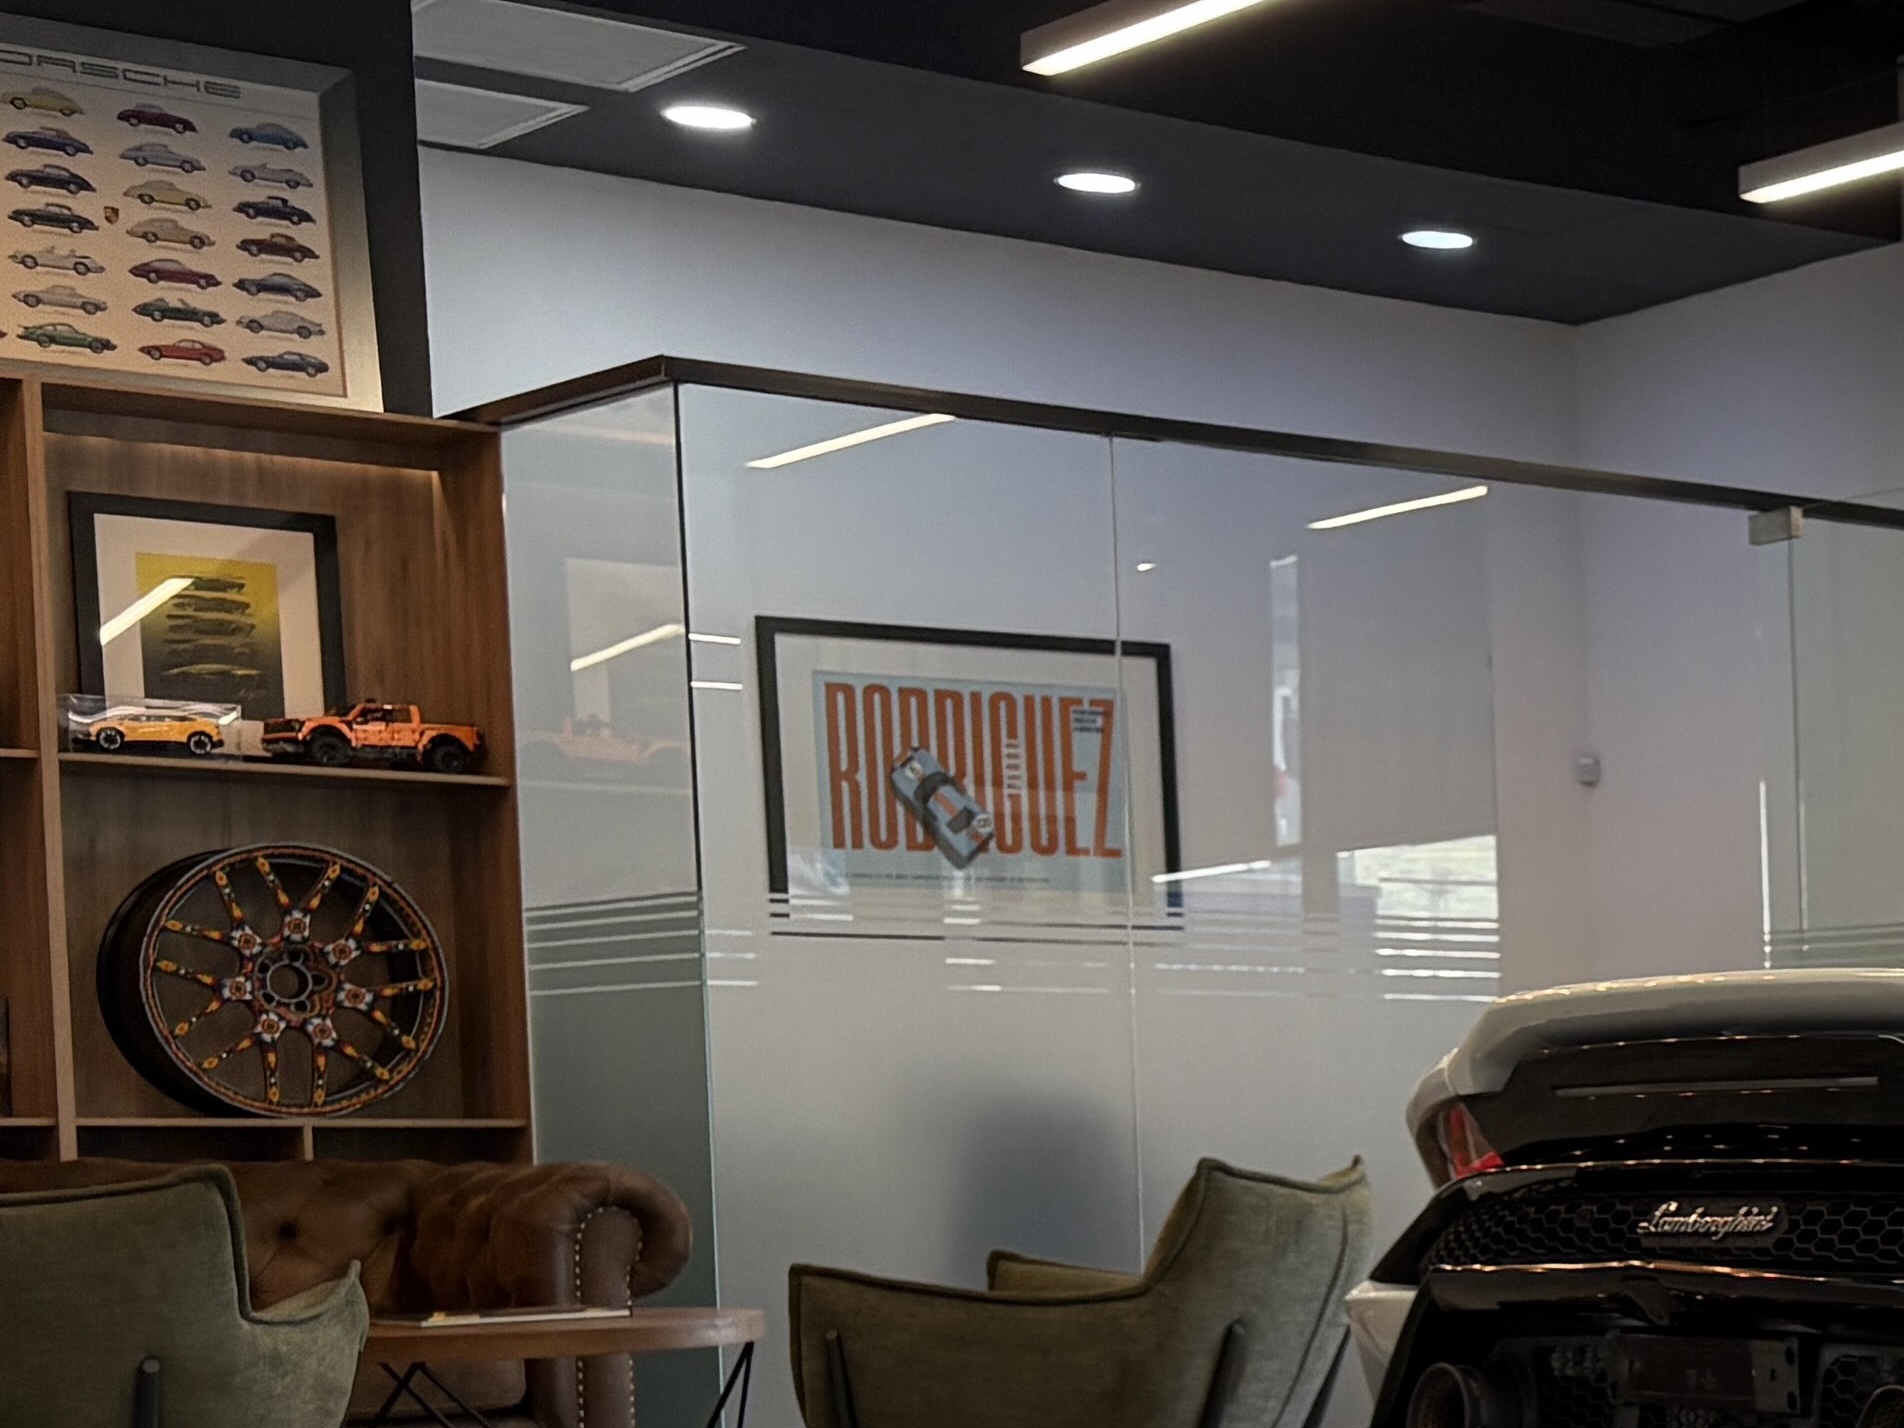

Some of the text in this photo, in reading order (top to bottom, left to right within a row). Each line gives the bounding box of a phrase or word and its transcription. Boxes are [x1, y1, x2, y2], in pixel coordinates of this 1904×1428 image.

[0, 50, 241, 99] ORSCHE
[823, 681, 1122, 859] RODRIGUEZ
[1637, 1200, 1778, 1240] Lamborghini
